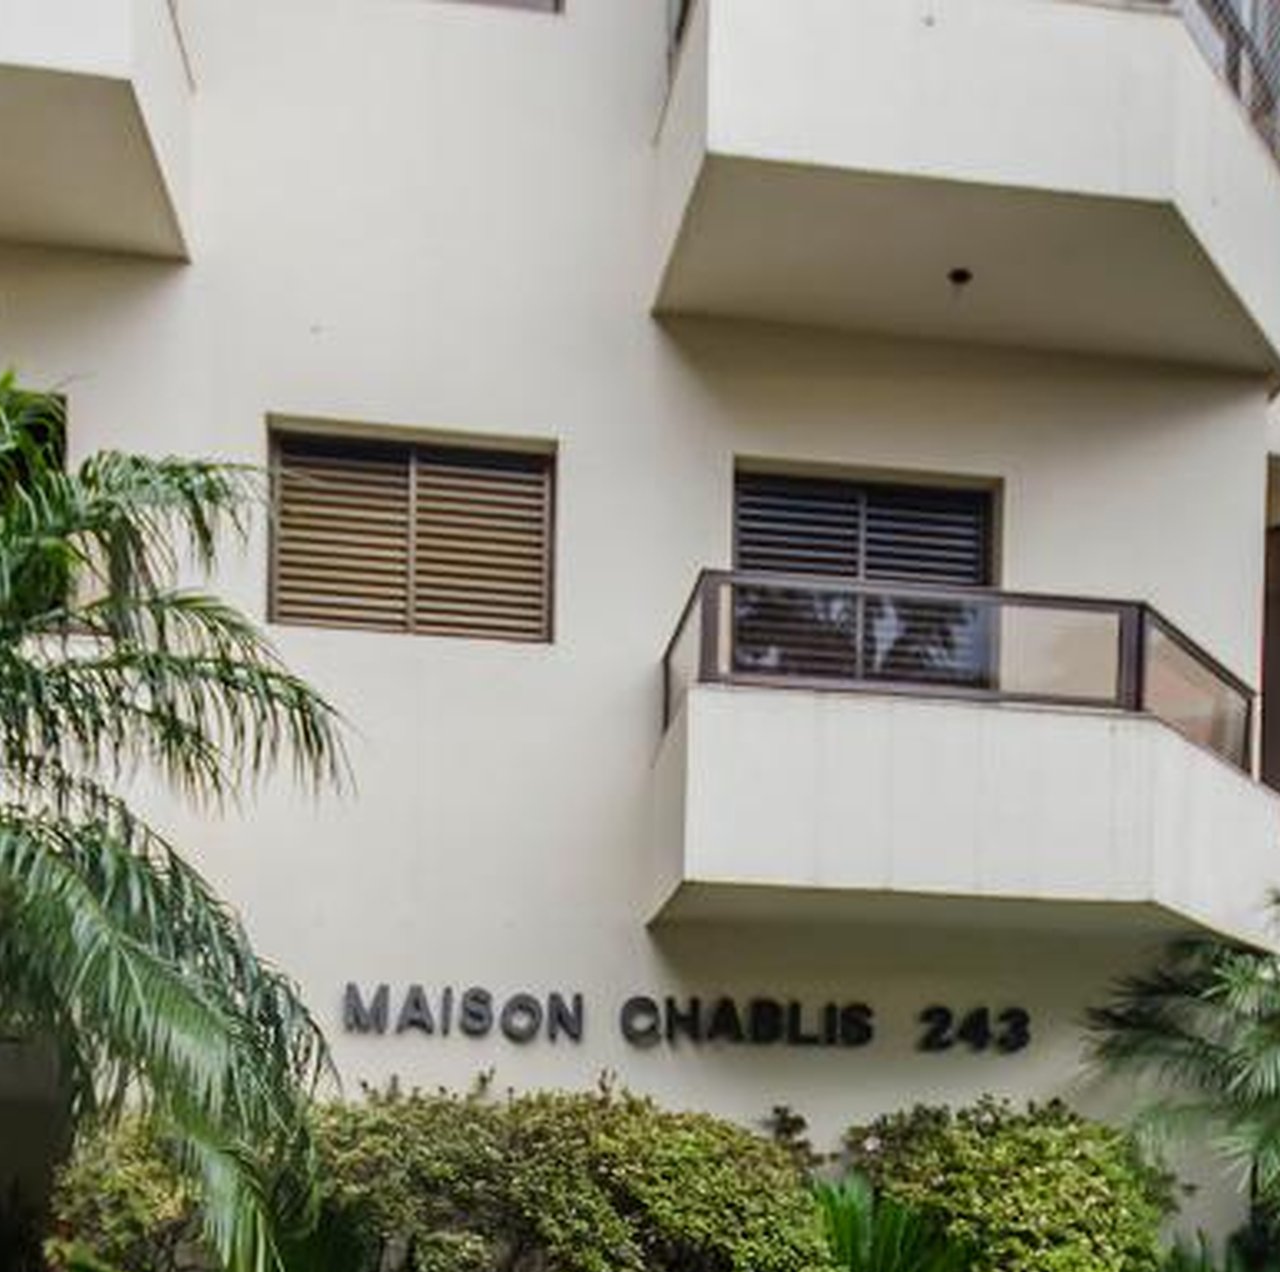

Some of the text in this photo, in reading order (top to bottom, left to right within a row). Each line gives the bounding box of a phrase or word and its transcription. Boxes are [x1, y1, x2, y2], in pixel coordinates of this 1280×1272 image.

[343, 981, 1031, 1054] MAISON CHABLIS 243
